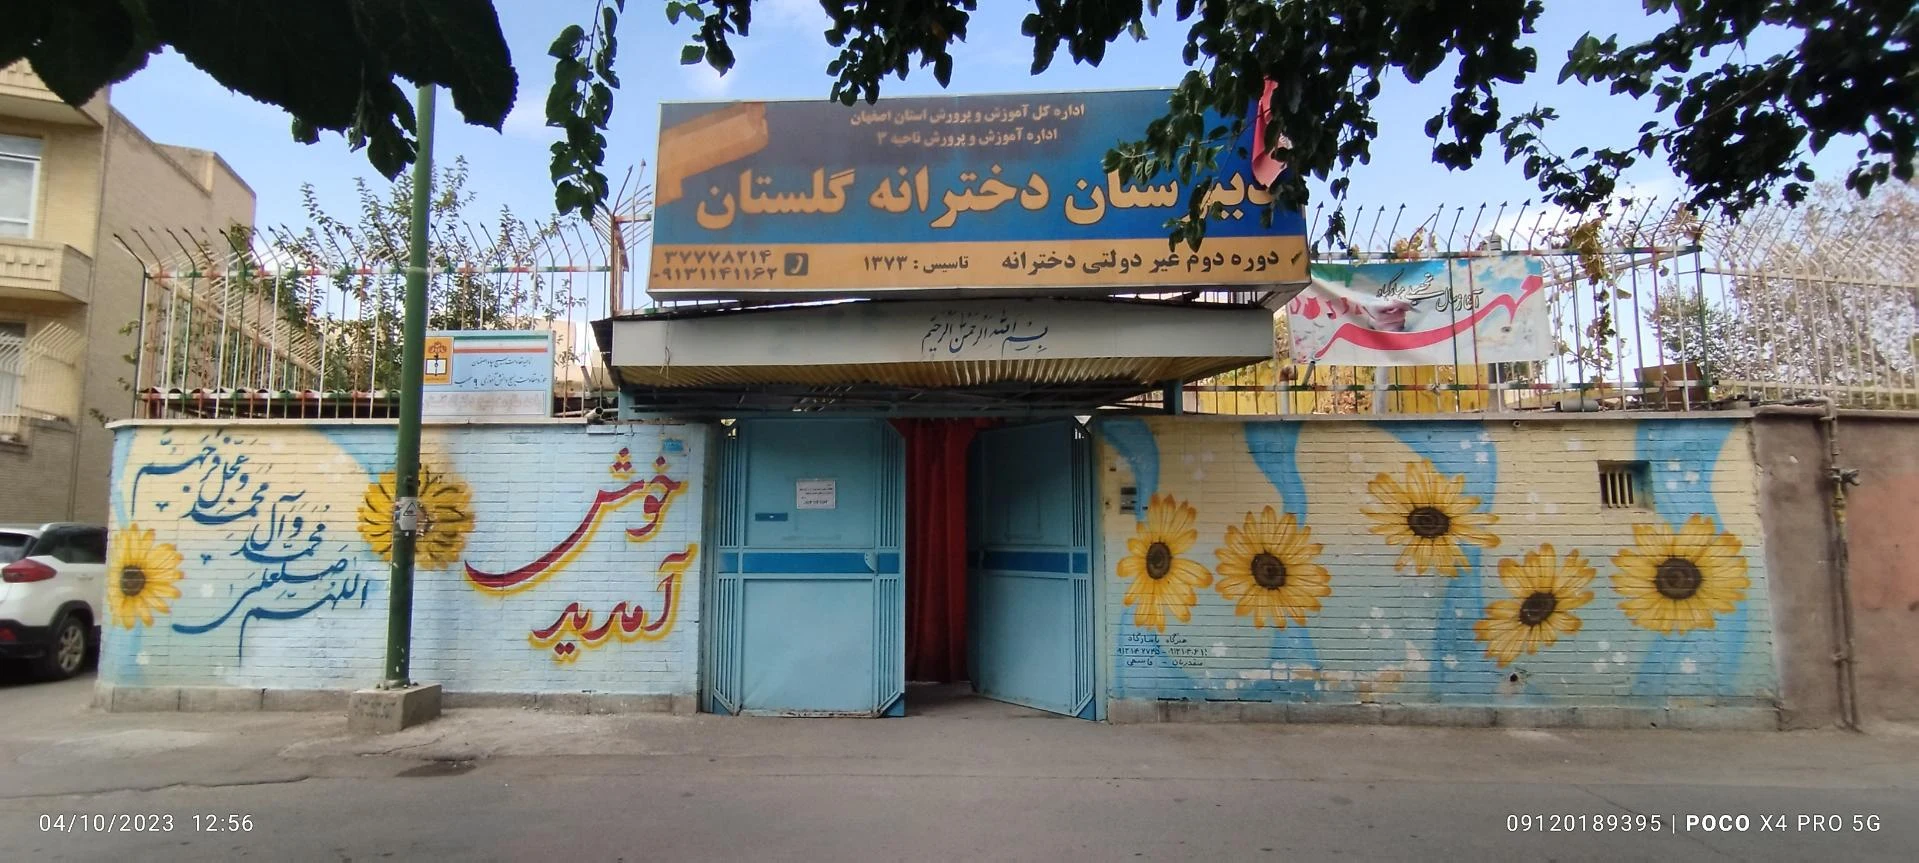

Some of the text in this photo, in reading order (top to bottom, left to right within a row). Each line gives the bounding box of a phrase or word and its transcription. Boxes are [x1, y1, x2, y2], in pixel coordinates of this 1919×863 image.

[850, 103, 1085, 126] اداره کل آموزش و پرورش استان اصفهان
[890, 131, 921, 145] ناحیه
[923, 131, 966, 147] پرورش
[968, 135, 976, 146] و
[978, 127, 1024, 146] آموزش
[1026, 128, 1058, 145] اداره
[696, 166, 855, 230] گلستان
[869, 163, 1050, 229] دخترانه
[664, 250, 772, 265] ۳۷۷۷۸۲۱۴
[863, 254, 908, 272] ۱۳۷۳
[923, 255, 969, 274] تاسیس
[1001, 249, 1279, 275] دوره دوم غیر دولتی دخترانه
[464, 447, 687, 594] خوش
[530, 545, 697, 661] آمدید
